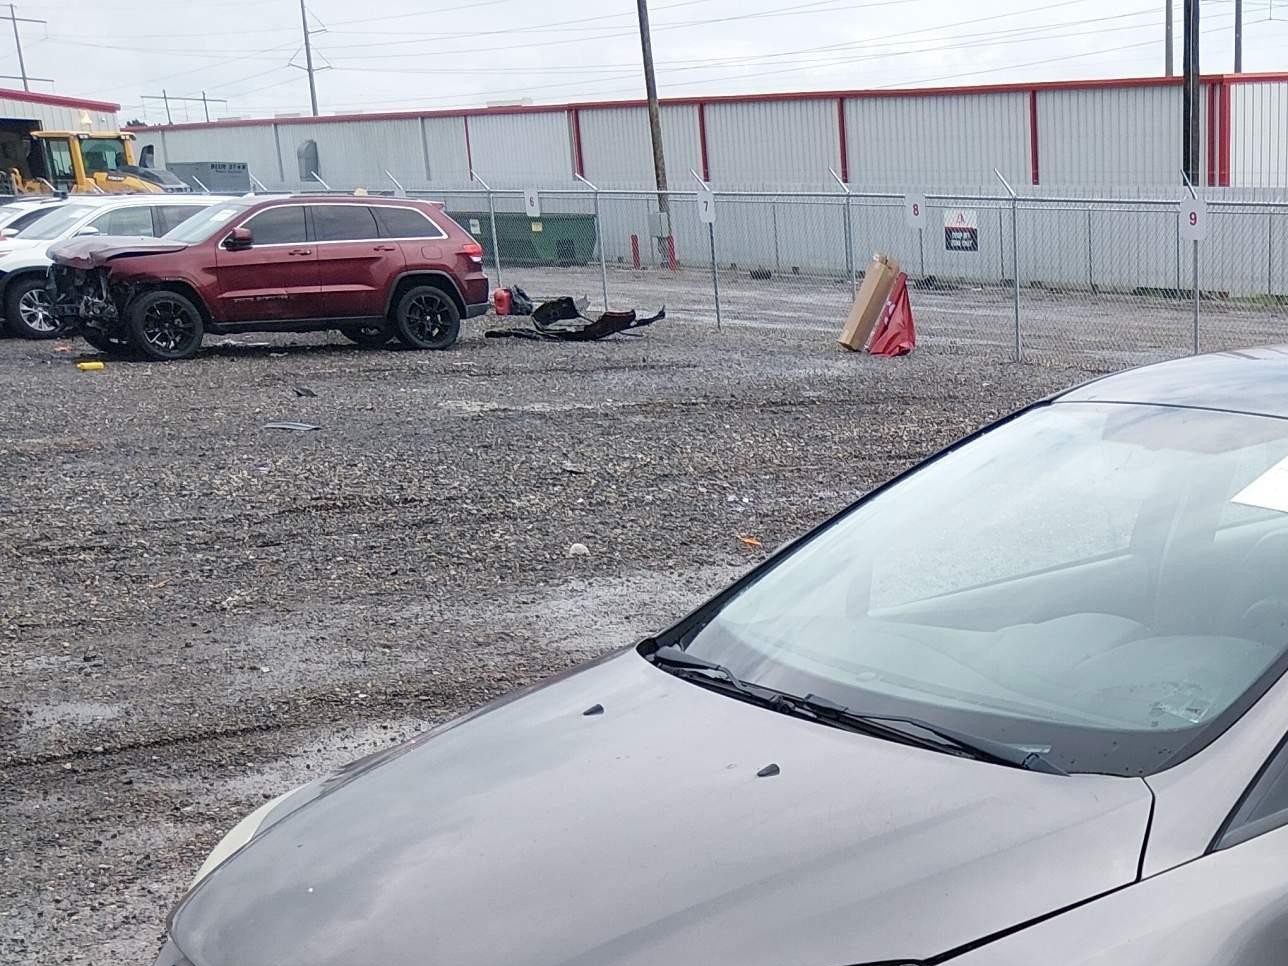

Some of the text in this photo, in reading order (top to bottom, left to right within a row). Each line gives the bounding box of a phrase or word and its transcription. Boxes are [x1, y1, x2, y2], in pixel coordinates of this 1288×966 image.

[529, 197, 535, 208] 6
[703, 201, 709, 212] 7
[912, 203, 920, 217] 8
[1189, 211, 1198, 226] 9
